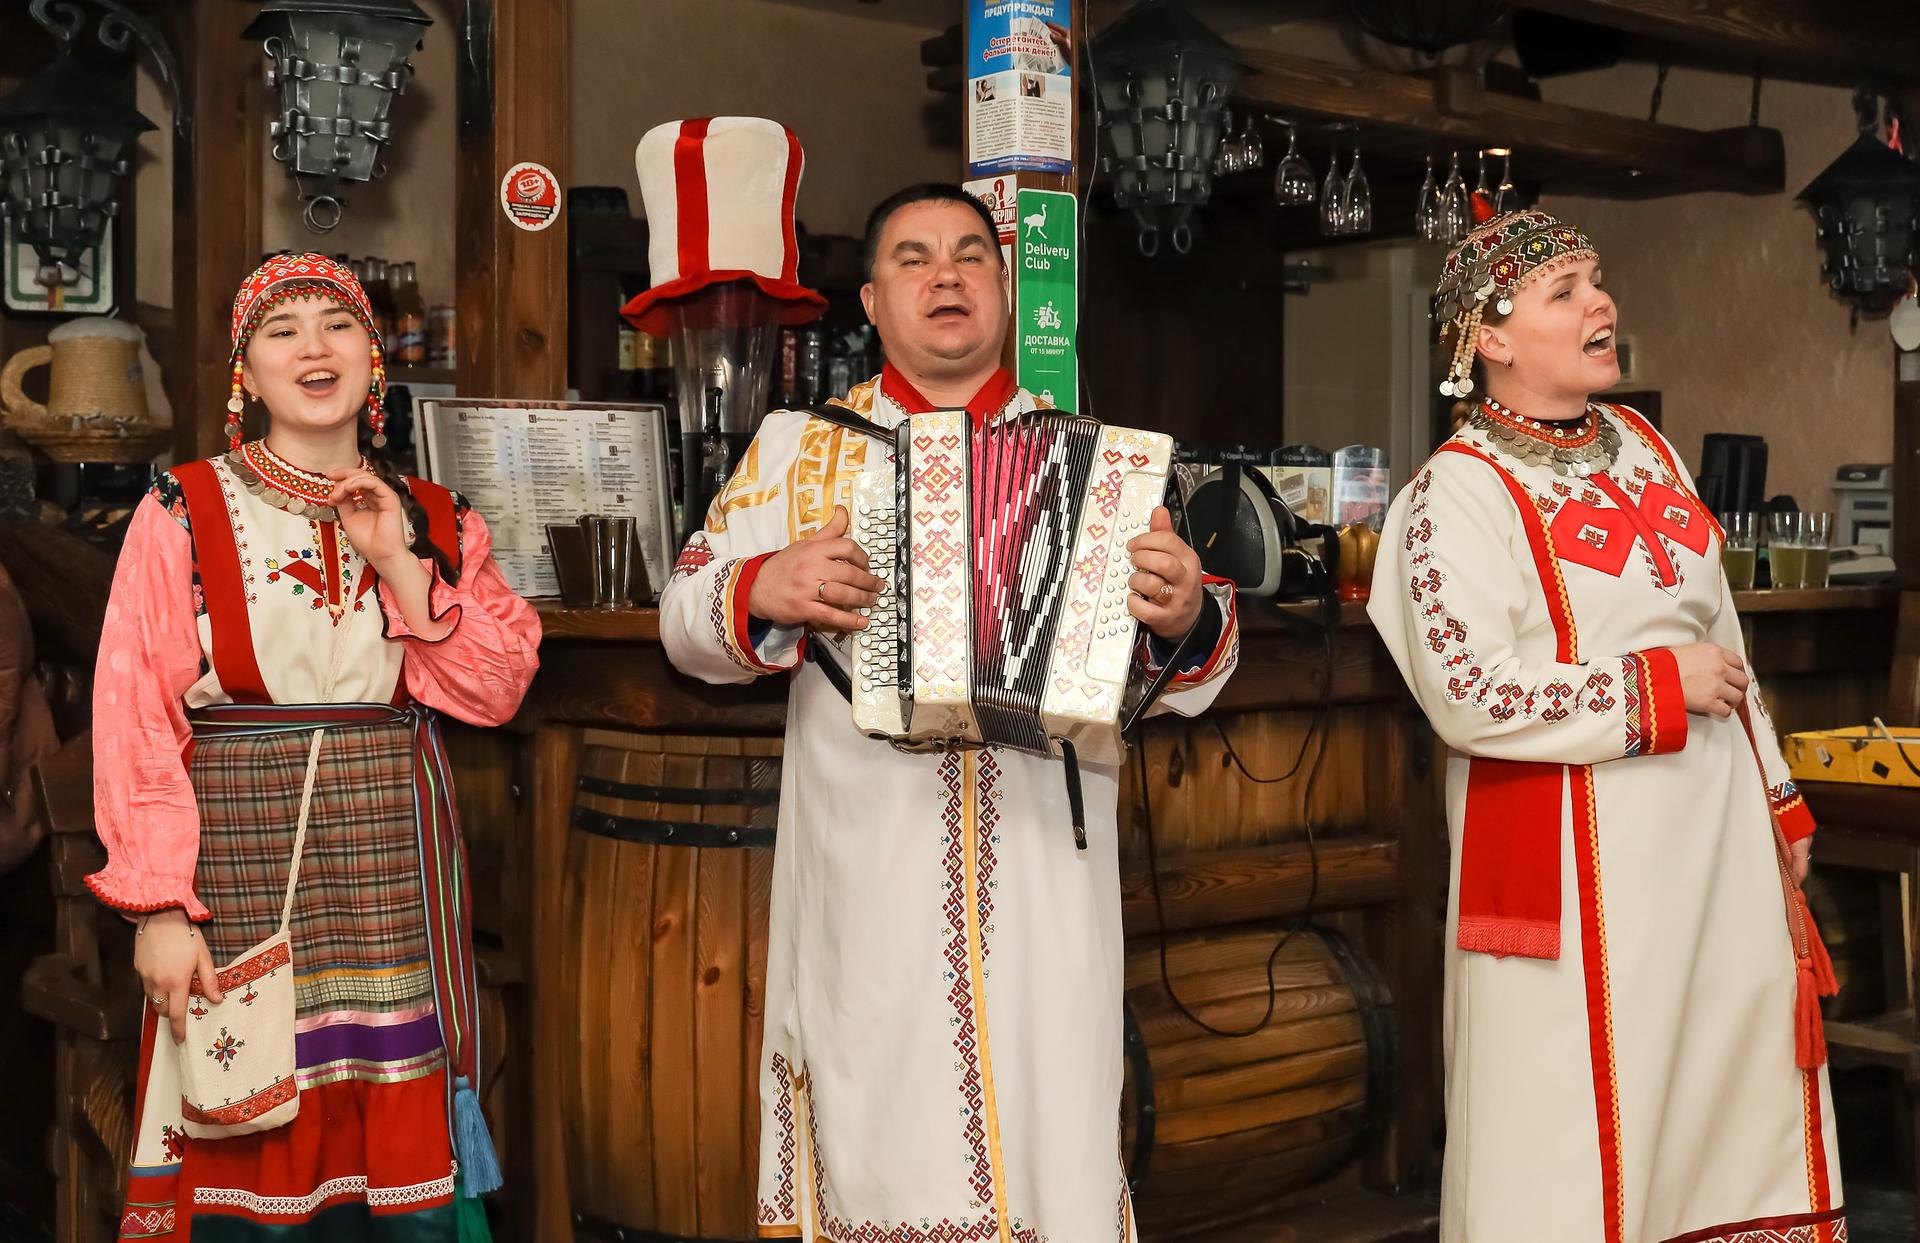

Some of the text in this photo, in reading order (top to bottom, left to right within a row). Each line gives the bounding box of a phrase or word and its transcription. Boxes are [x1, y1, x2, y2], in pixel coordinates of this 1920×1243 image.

[984, 2, 1055, 19] ПРЕДУПРЕЖДАЕТ
[990, 36, 1048, 48] Остерегайтесь
[983, 46, 1057, 60] фальшивых денег!
[1025, 242, 1070, 260] Delivery
[1025, 257, 1051, 270] Club
[1024, 335, 1071, 347] ДОСТАВКА
[1030, 347, 1038, 355] ОТ
